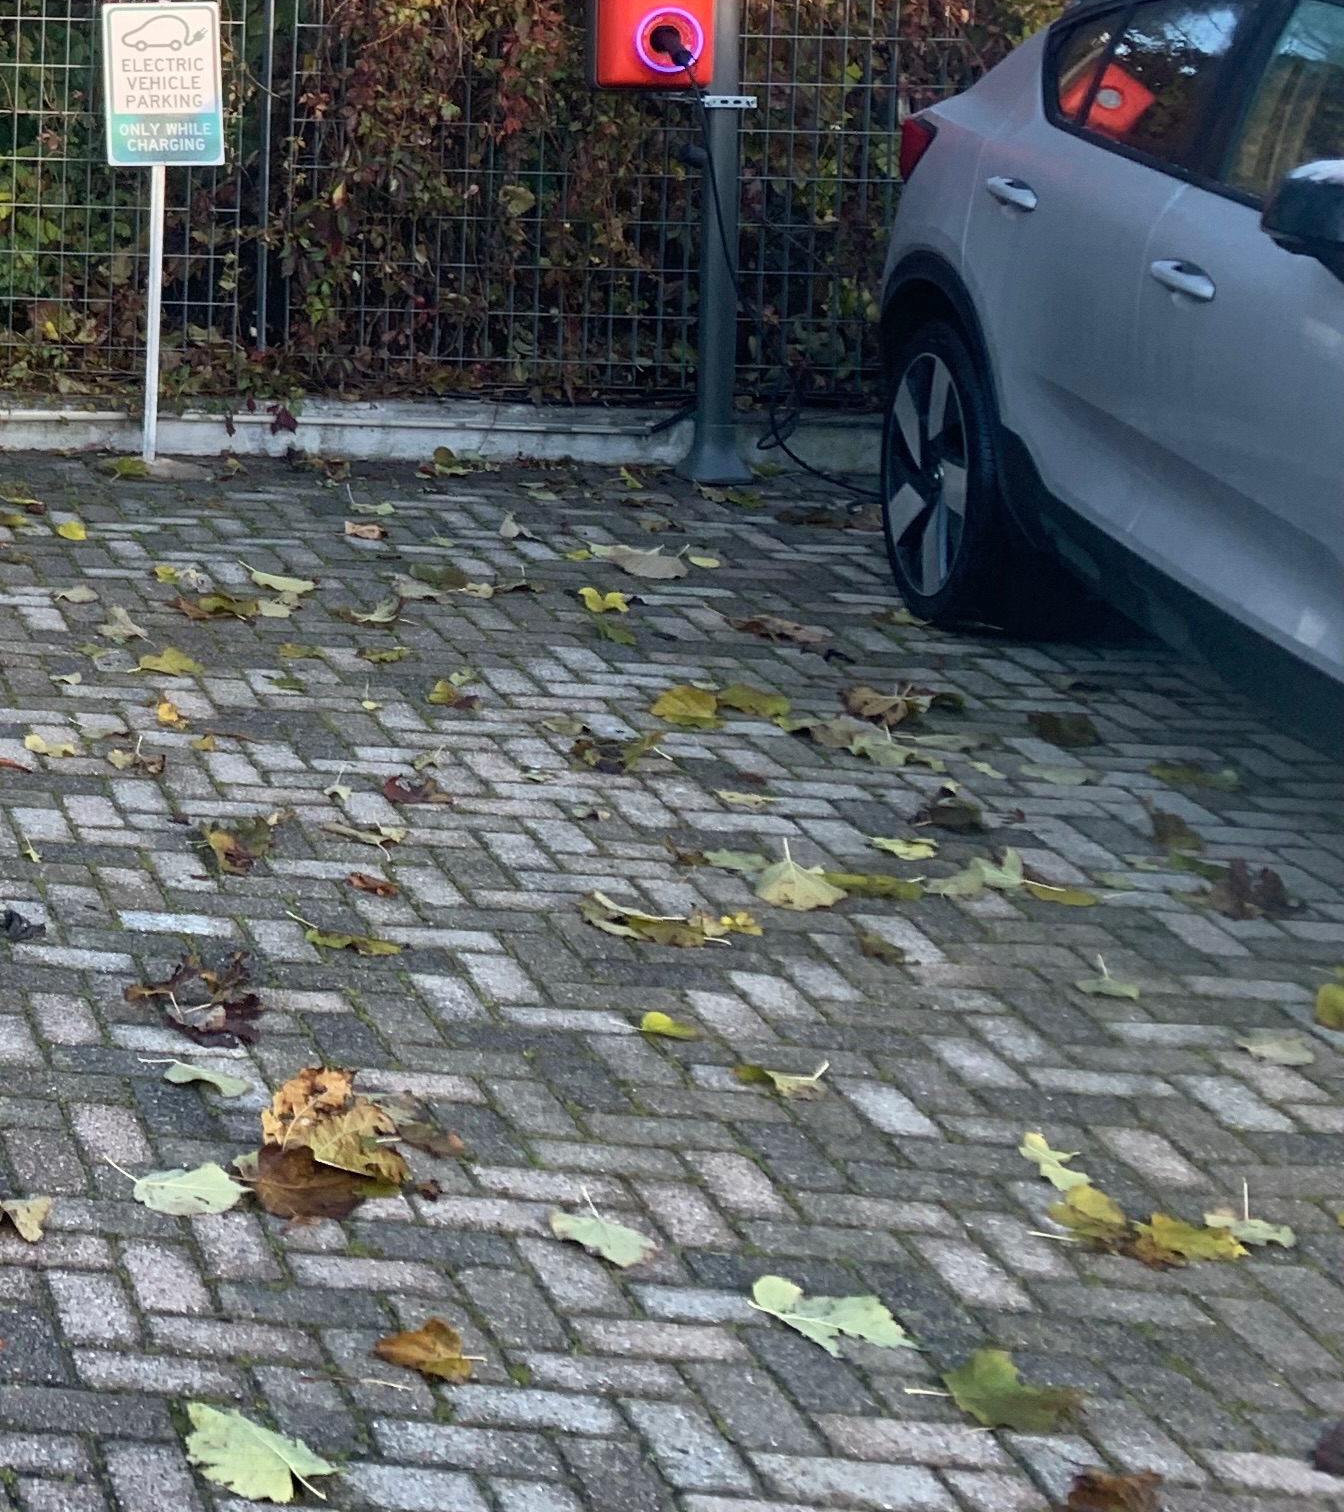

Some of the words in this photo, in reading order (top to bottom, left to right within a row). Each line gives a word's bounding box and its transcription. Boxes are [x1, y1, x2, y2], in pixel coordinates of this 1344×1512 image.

[122, 57, 204, 72] ELECTRIC
[127, 76, 201, 90] VEHICLE
[126, 94, 203, 108] PARKING
[119, 123, 160, 136] ONLY
[166, 122, 212, 135] WHILE
[127, 139, 206, 152] CHARGING
